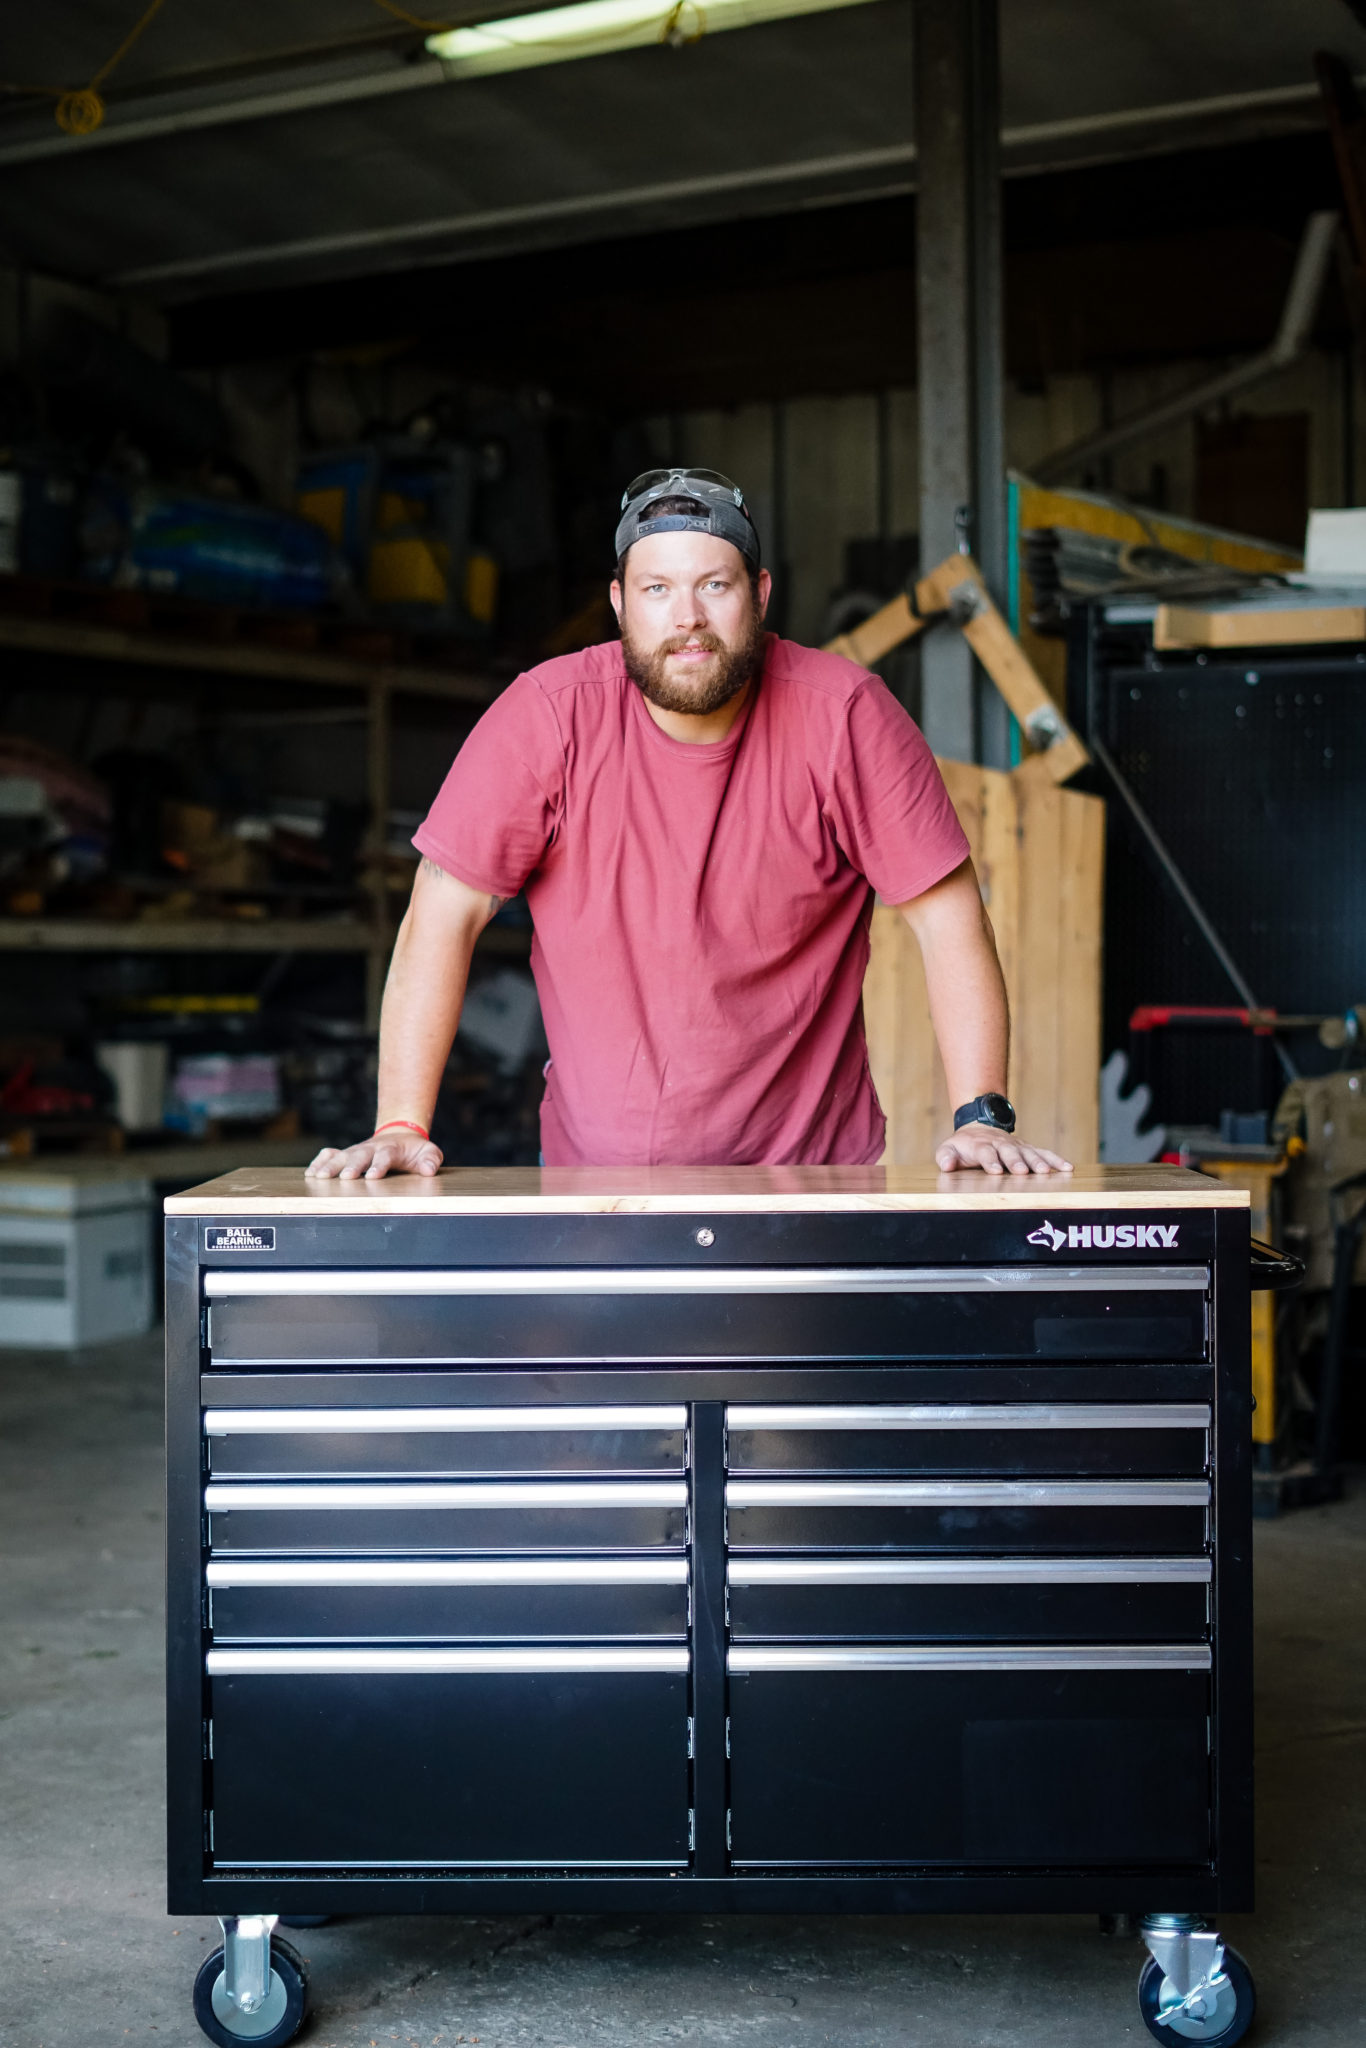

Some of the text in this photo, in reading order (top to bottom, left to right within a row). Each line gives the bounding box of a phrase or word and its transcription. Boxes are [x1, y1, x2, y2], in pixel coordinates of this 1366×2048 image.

[226, 1228, 252, 1237] BALL
[1068, 1225, 1180, 1248] HUSKY
[216, 1236, 262, 1245] BEARING
